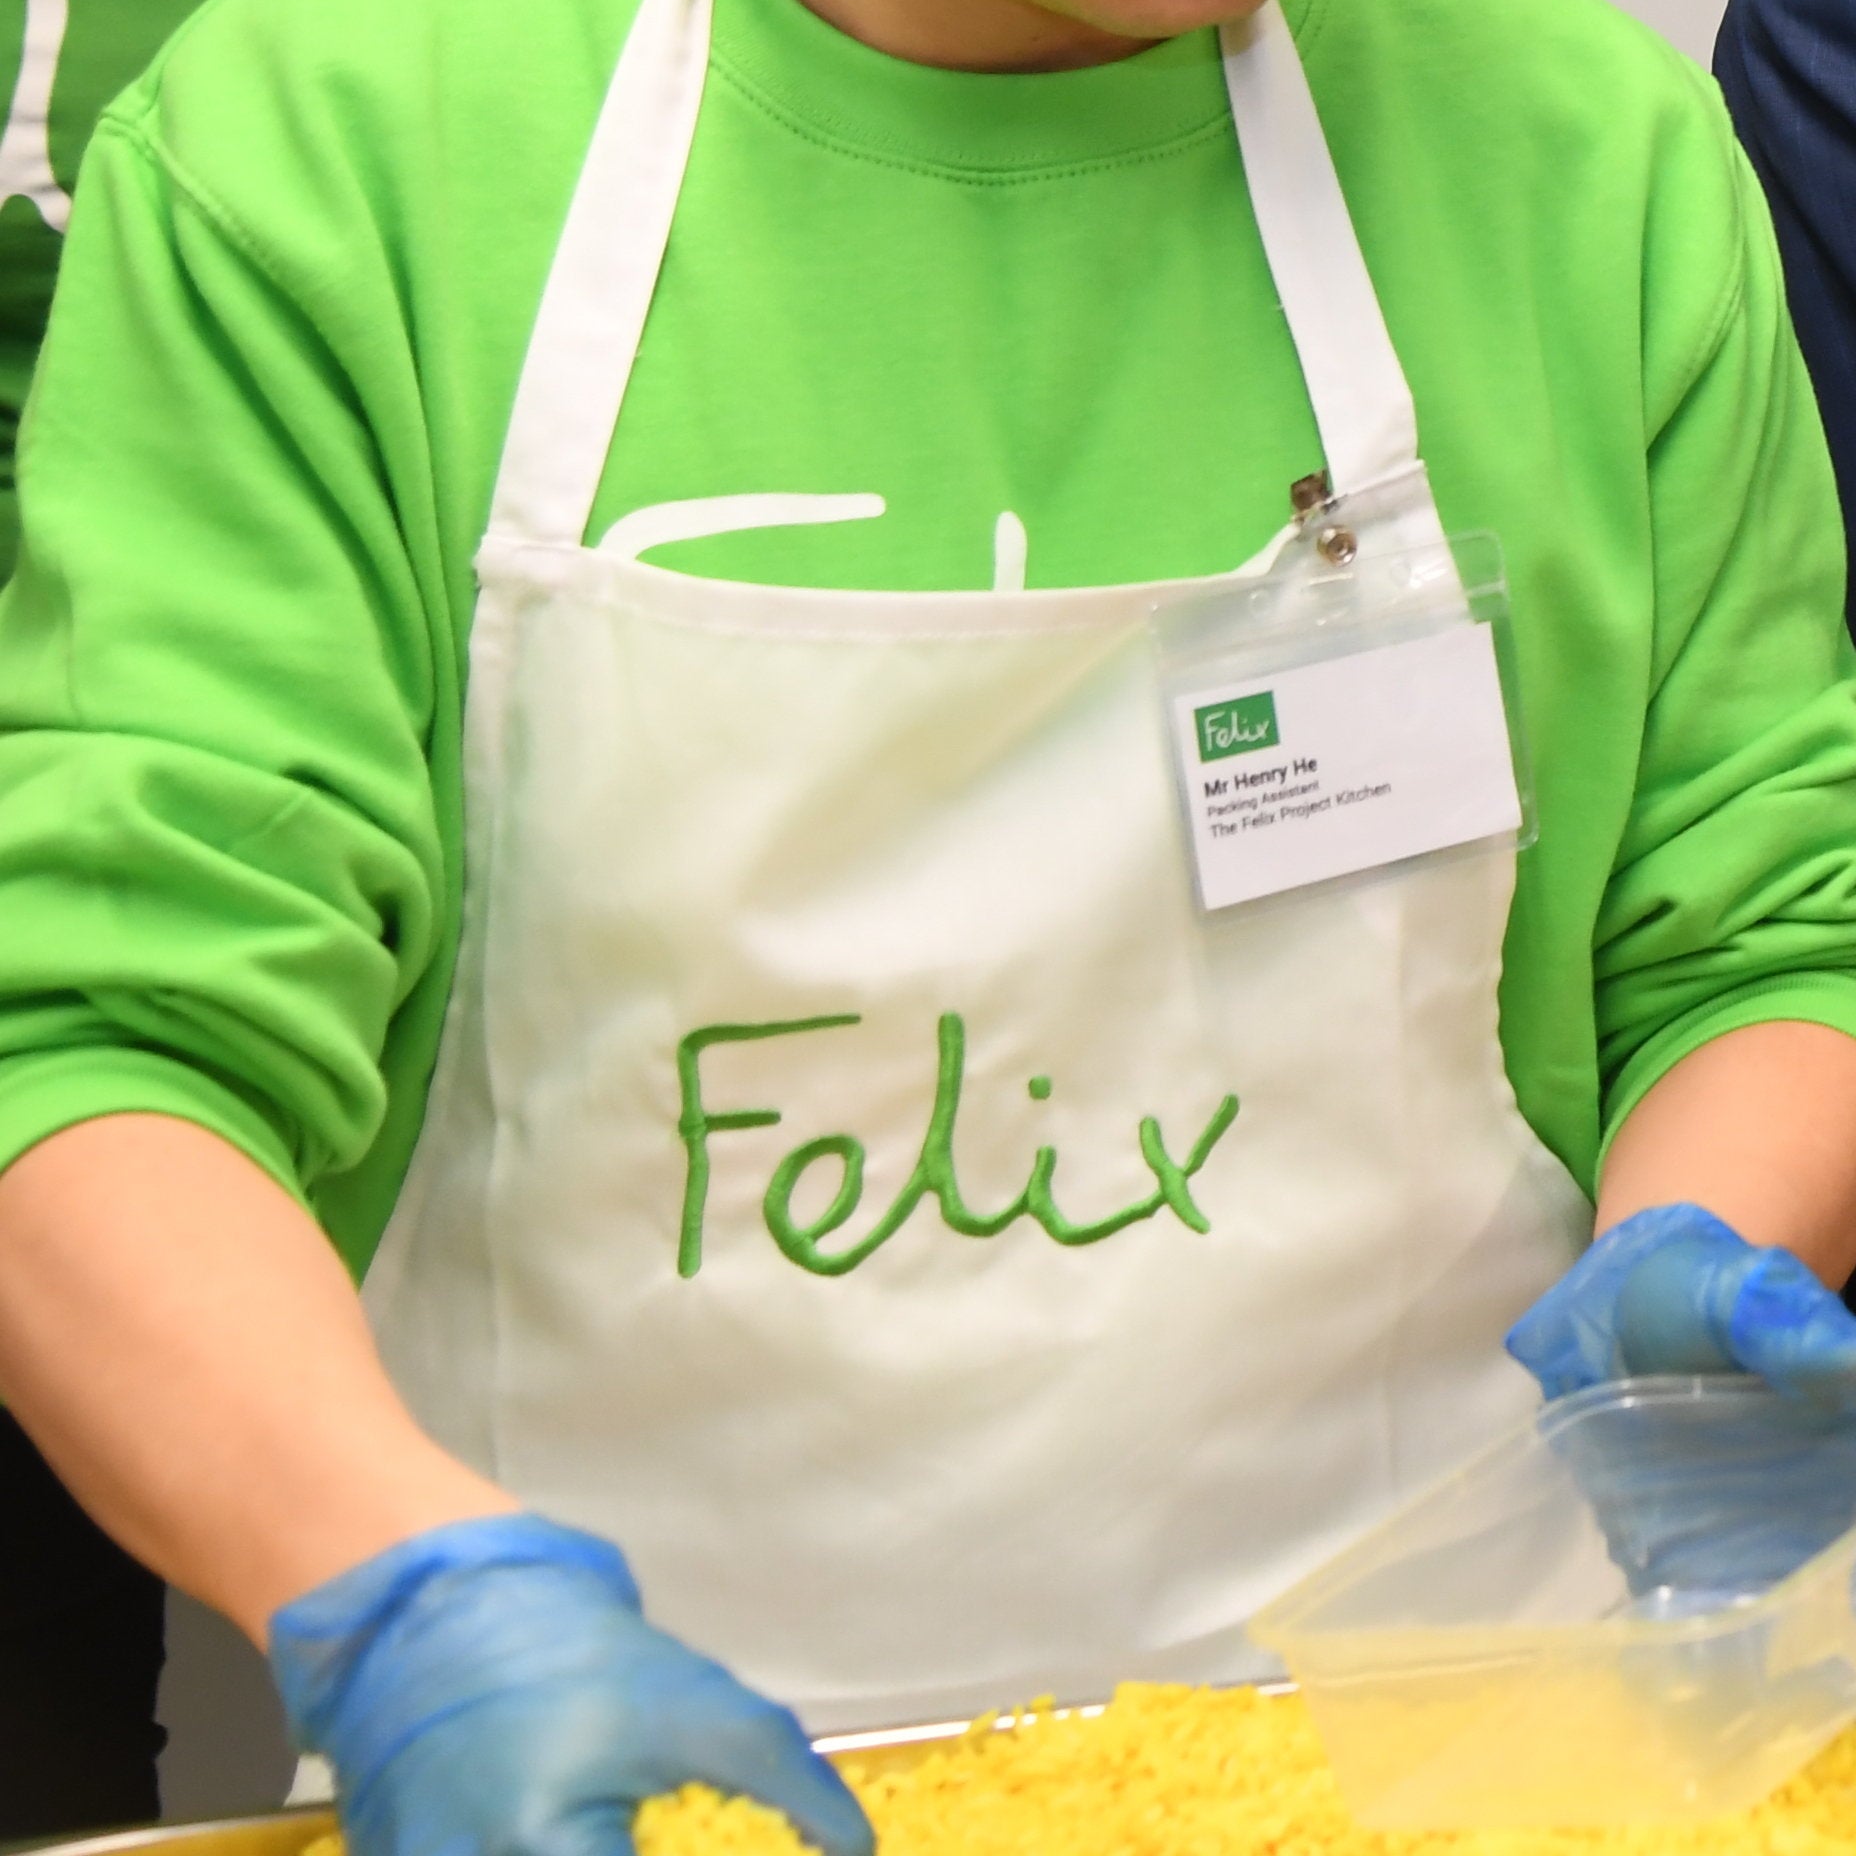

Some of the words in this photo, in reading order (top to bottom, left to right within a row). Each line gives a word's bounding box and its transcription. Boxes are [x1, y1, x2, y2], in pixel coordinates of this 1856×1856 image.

[1204, 710, 1270, 753] Felix
[1204, 778, 1229, 798] Mr
[1234, 765, 1288, 791] Henry
[1293, 758, 1318, 776] He
[1207, 796, 1259, 817] Packing
[1261, 780, 1320, 804] Assistant
[1209, 821, 1238, 839] The
[1241, 811, 1275, 831] Felix
[1280, 795, 1332, 821] Project
[1336, 782, 1392, 805] Kitchen
[677, 1011, 1240, 1279] Felix
